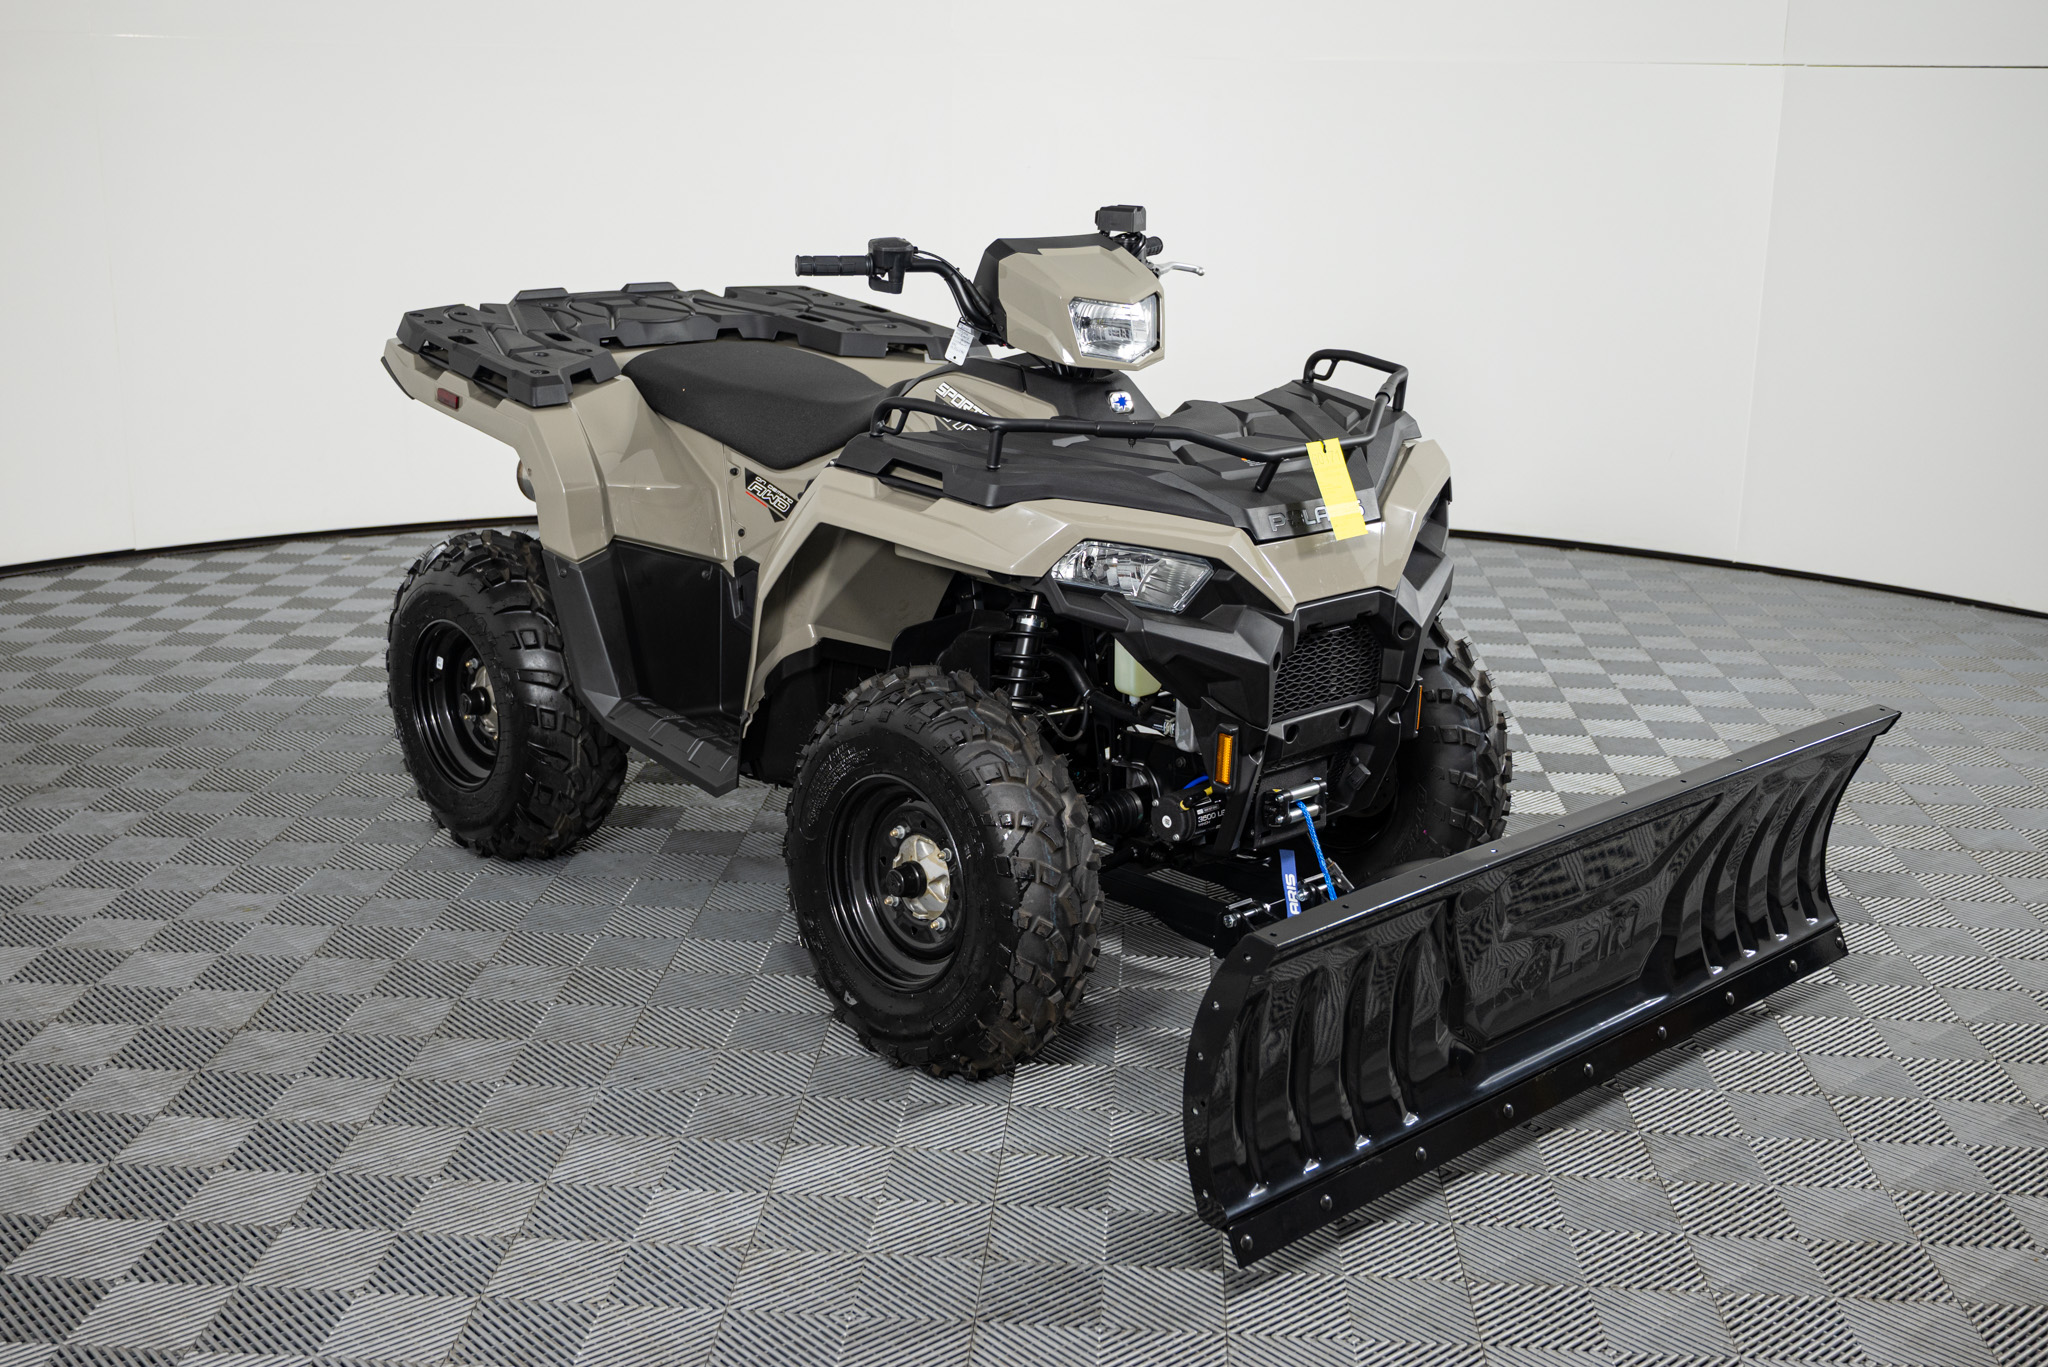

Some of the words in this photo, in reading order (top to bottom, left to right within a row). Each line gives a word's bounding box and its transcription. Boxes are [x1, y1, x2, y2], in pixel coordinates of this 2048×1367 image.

[935, 382, 990, 417] SPORT
[747, 481, 790, 513] AWD
[1493, 902, 1639, 1008] KOLPIN
